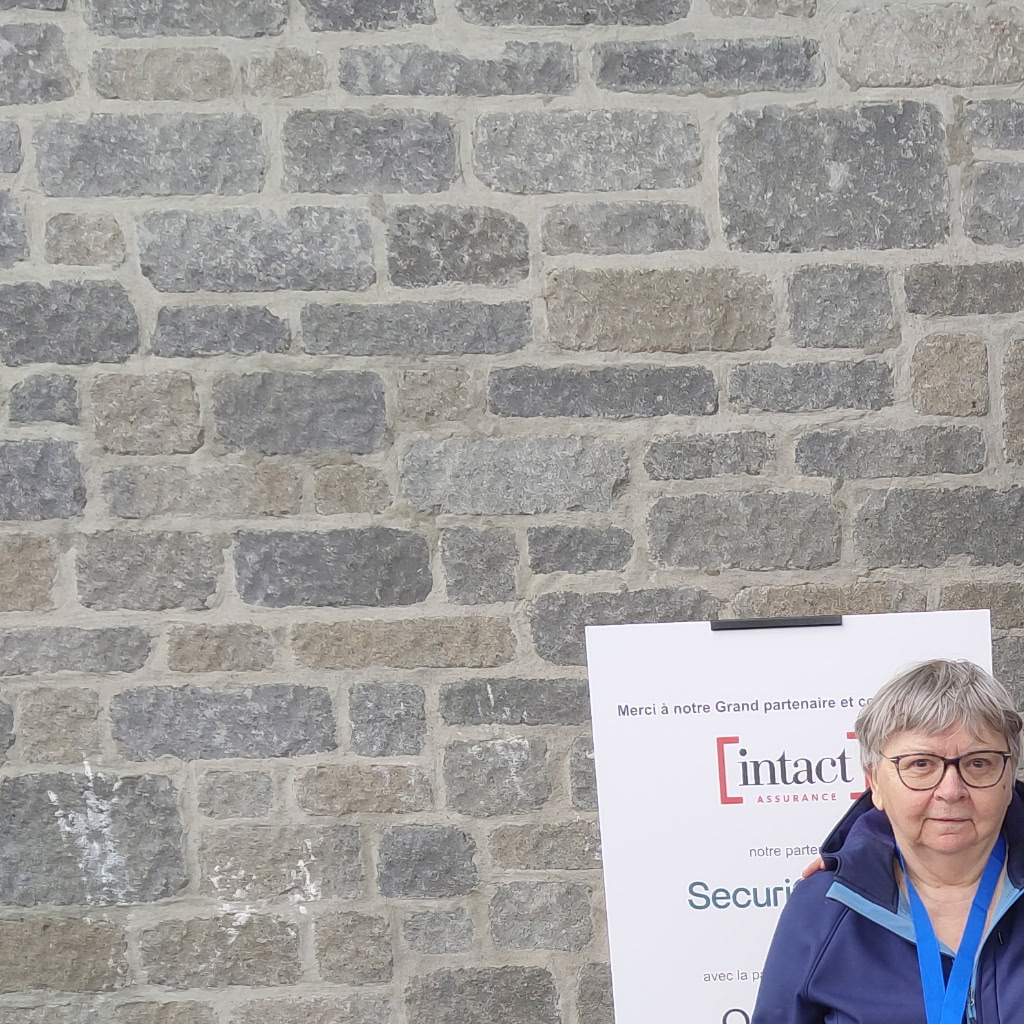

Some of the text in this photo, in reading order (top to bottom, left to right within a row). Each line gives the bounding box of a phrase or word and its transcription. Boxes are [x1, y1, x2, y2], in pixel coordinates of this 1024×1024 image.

[617, 702, 657, 717] Merci
[660, 702, 669, 715] à
[673, 703, 711, 715] notre
[715, 699, 759, 713] Grand
[764, 696, 836, 714] partenaire
[840, 696, 854, 708] et
[737, 747, 855, 787] intact
[756, 792, 838, 804] ASSURANCE
[749, 844, 821, 858] notre parte
[687, 878, 792, 910] Securi
[703, 971, 734, 982] avec
[737, 969, 748, 981] la
